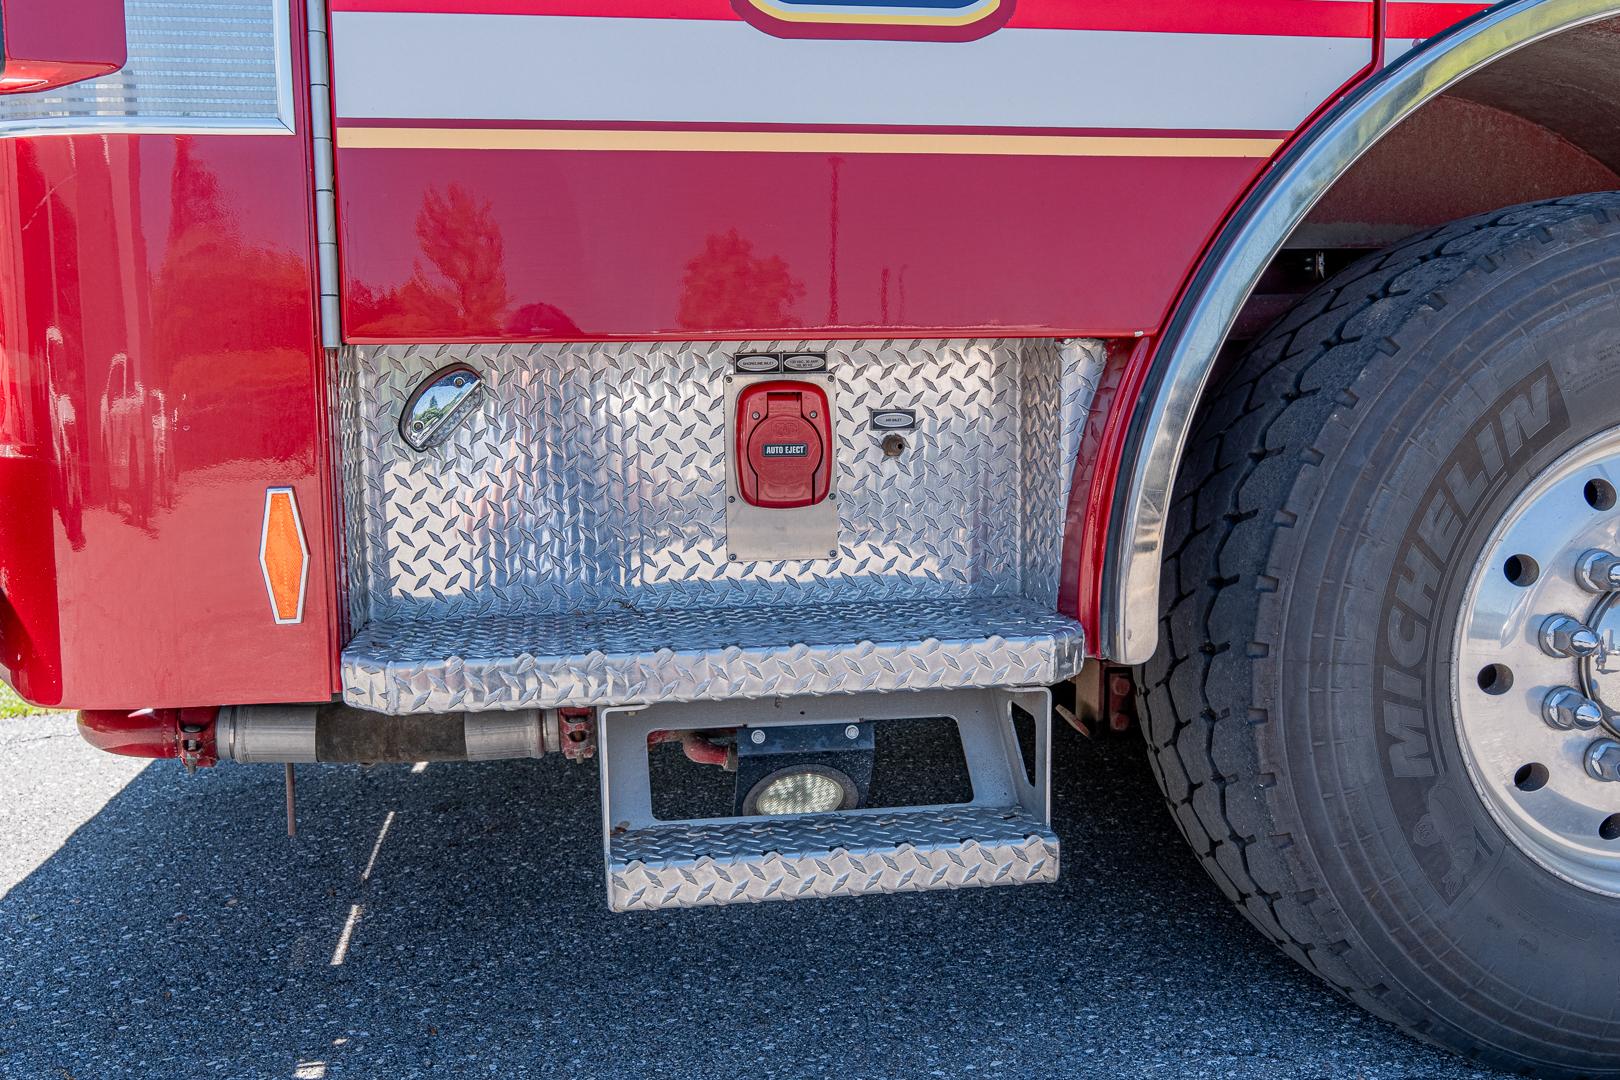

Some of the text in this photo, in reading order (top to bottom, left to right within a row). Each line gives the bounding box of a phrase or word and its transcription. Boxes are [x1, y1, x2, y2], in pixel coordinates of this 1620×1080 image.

[766, 446, 804, 454] AUTO EJECT
[1383, 374, 1551, 778] MICHELIN
